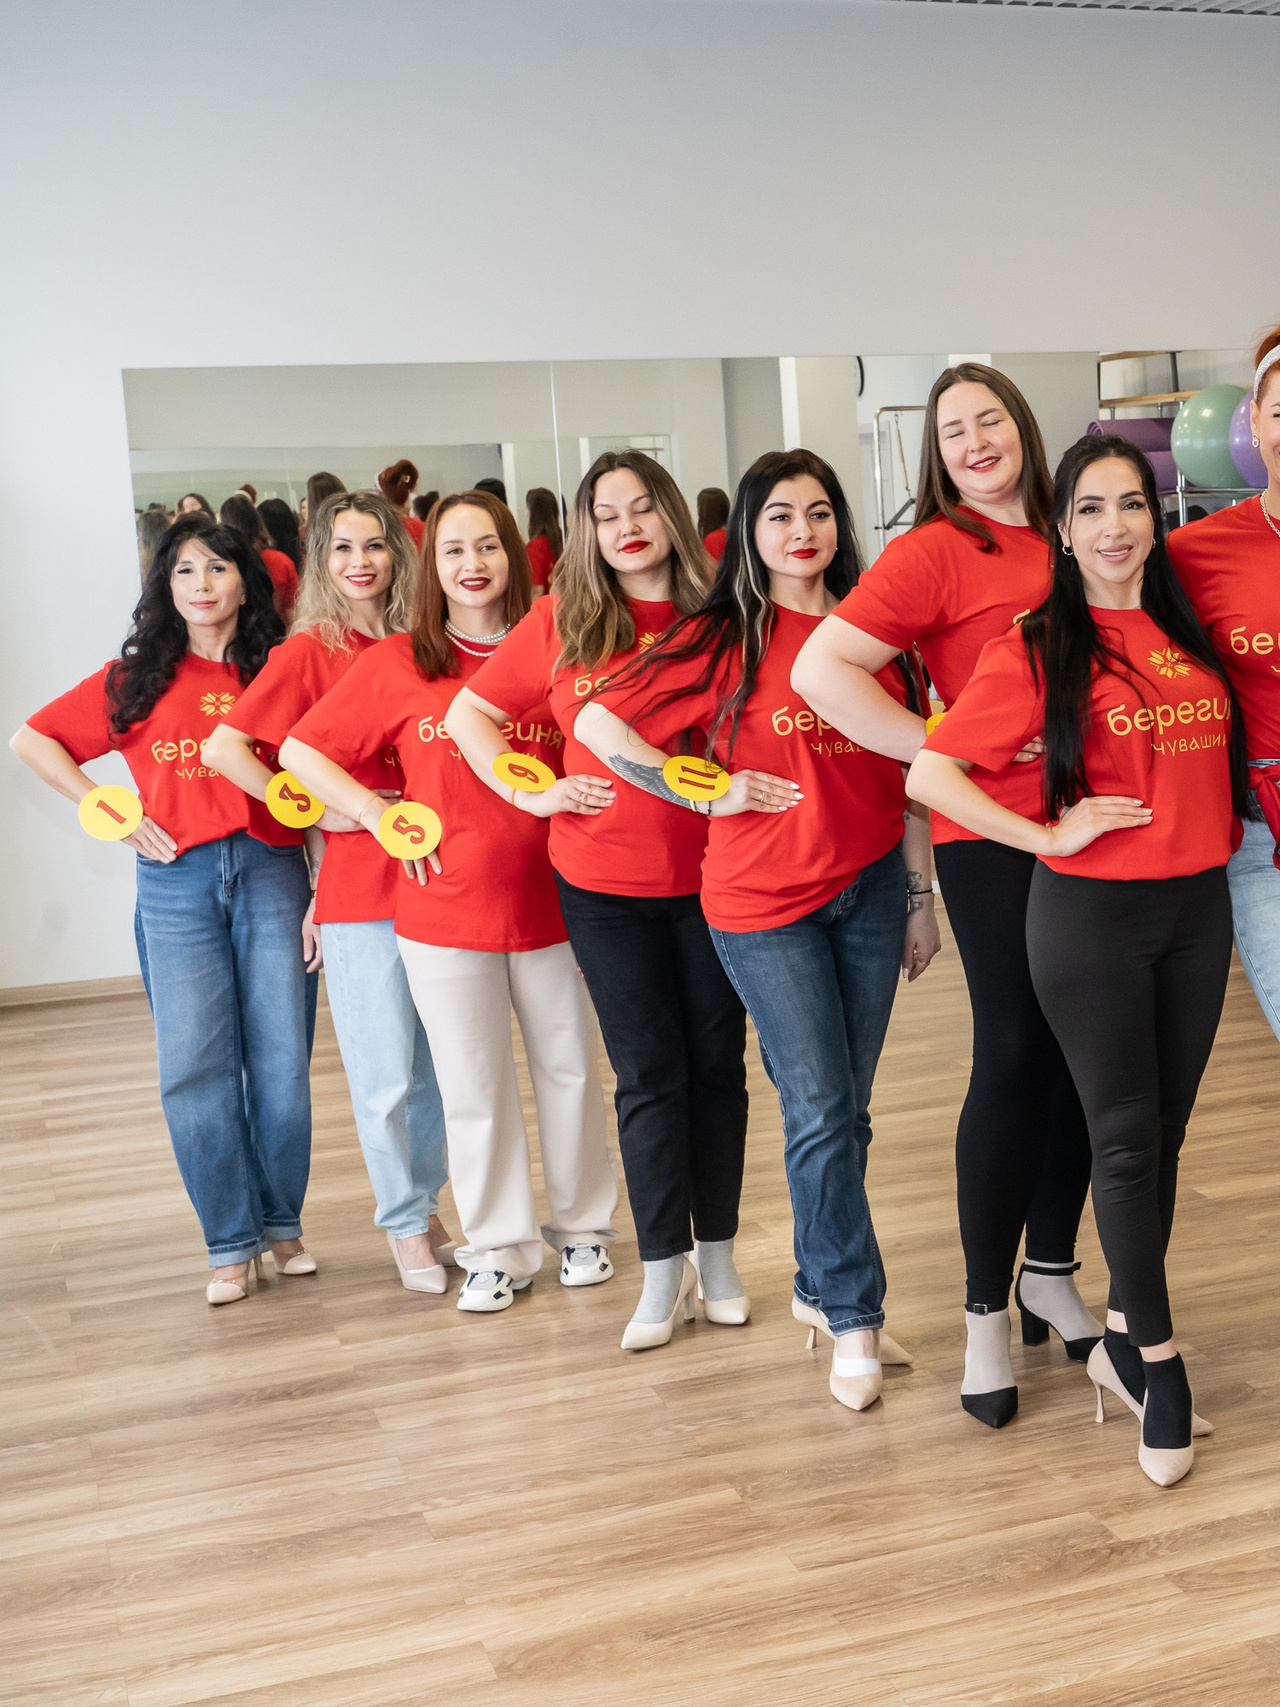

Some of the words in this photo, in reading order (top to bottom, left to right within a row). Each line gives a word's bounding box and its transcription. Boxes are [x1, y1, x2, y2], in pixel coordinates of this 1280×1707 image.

[1107, 698, 1231, 736] береги
[810, 741, 868, 757] чува
[678, 765, 718, 790] 11
[279, 783, 311, 812] 3
[96, 800, 126, 824] 1
[392, 815, 426, 844] 5
